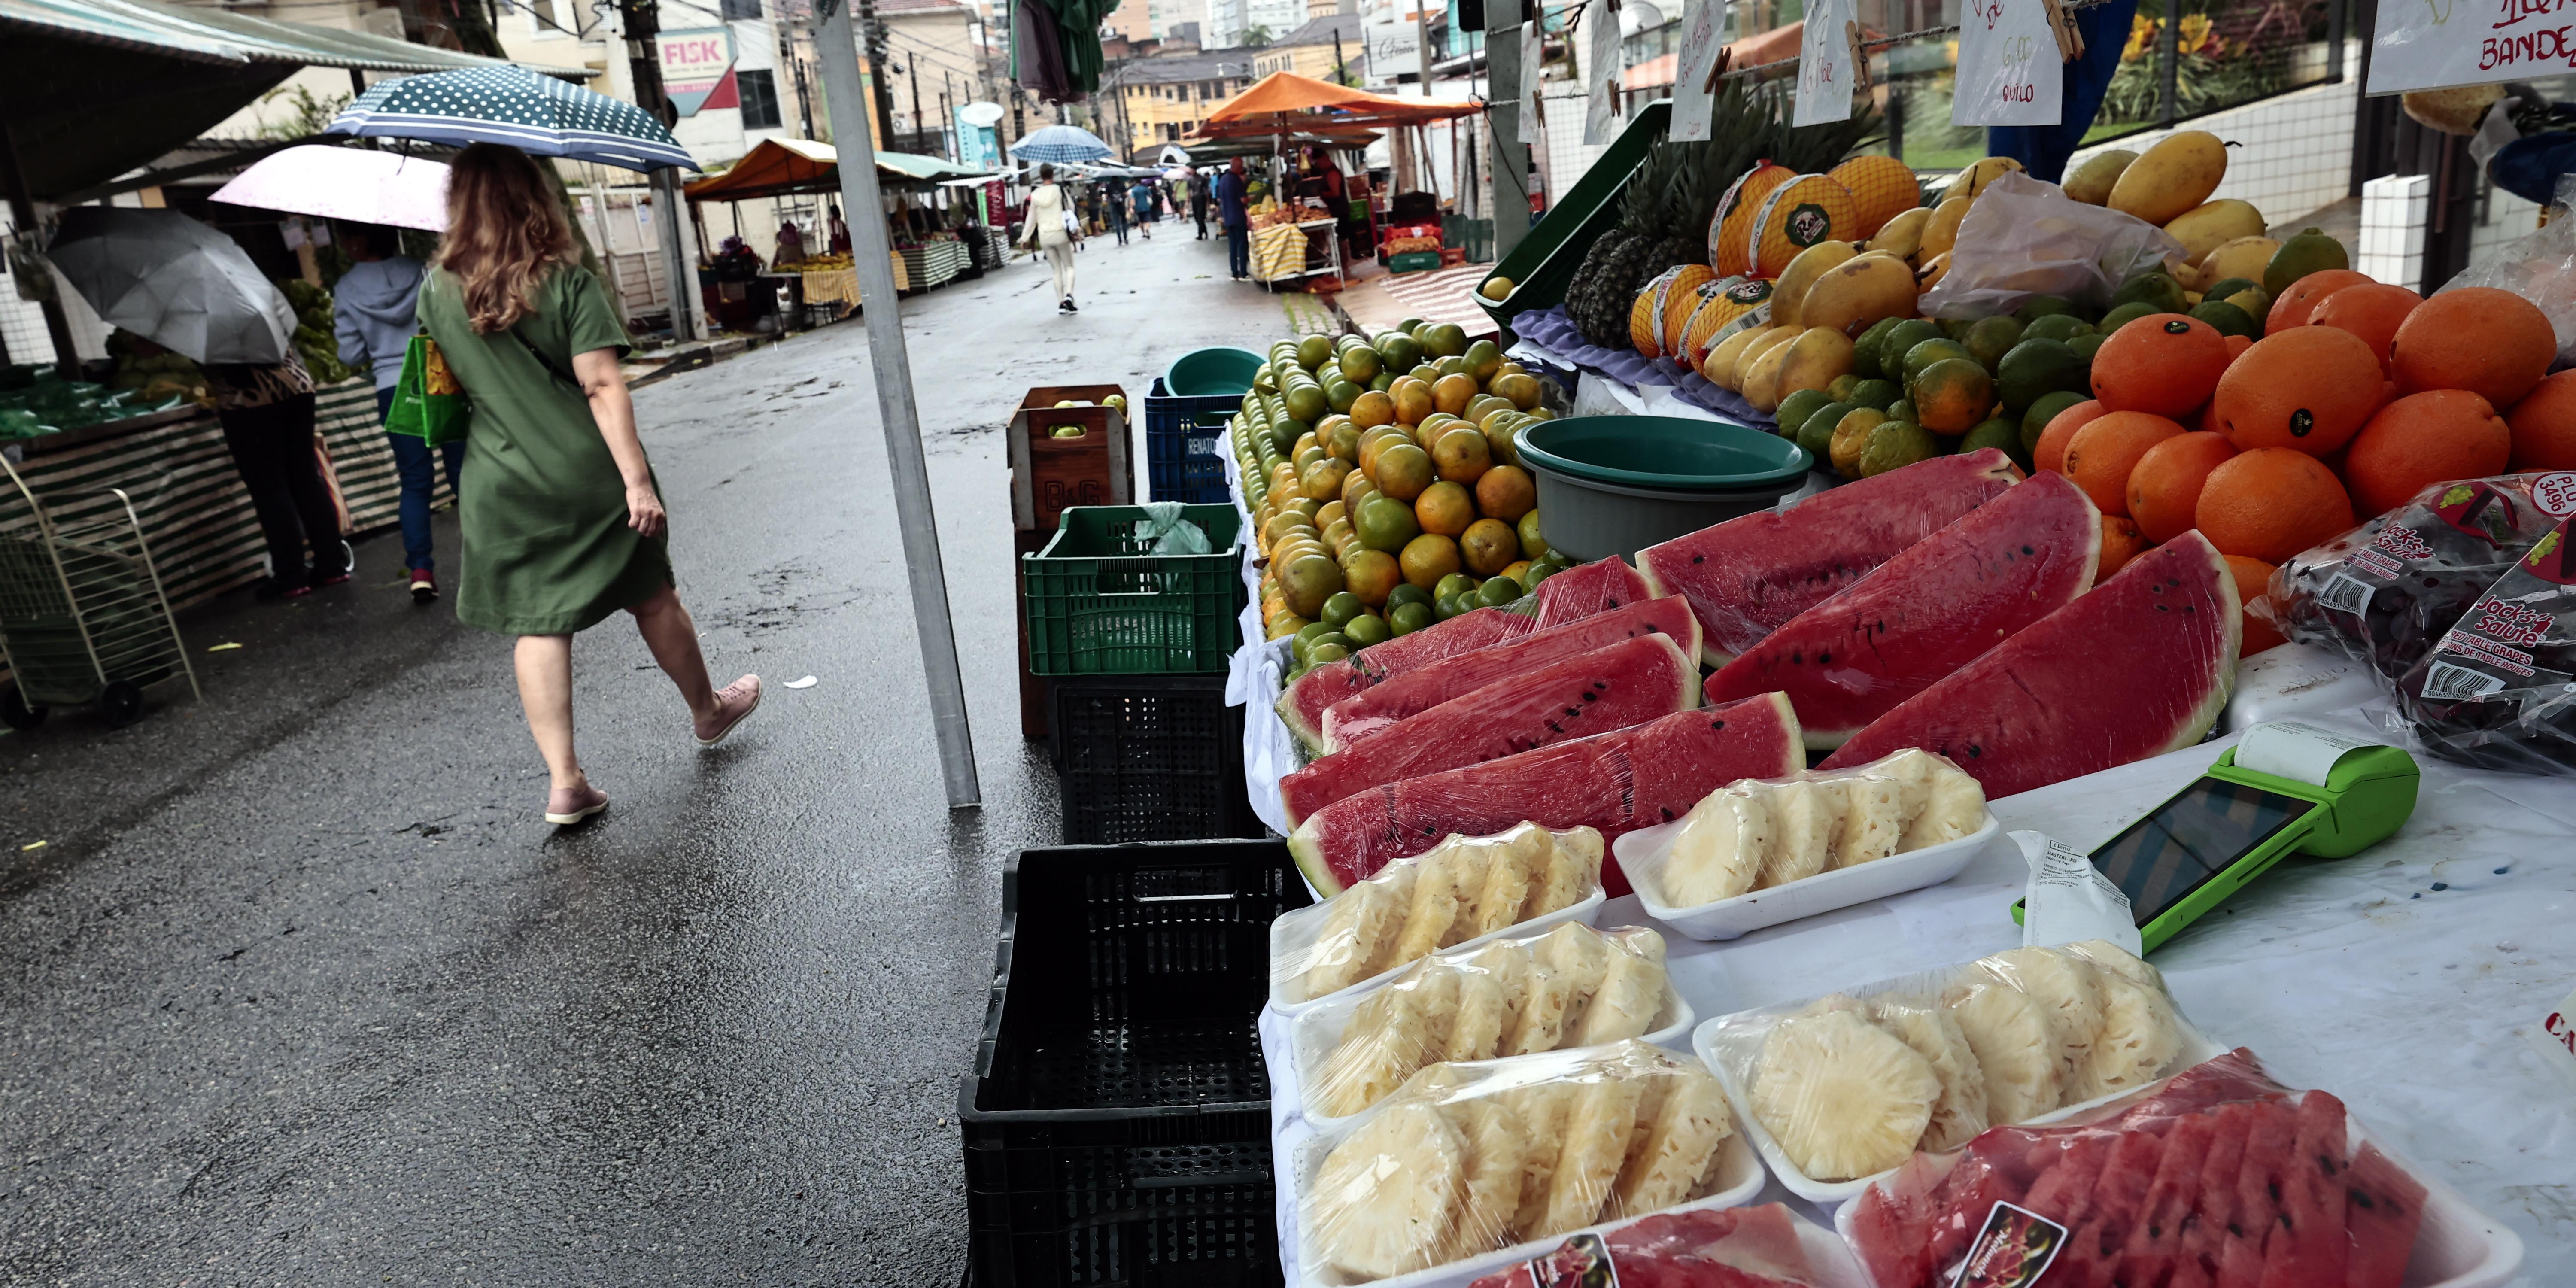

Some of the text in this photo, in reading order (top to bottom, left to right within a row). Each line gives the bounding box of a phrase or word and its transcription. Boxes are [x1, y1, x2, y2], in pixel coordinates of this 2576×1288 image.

[664, 40, 721, 65] FISK
[1188, 438, 1217, 455] RENATO
[1045, 480, 1101, 511] B&G
[2539, 480, 2566, 512] 3496
[2556, 476, 2576, 502] PLU
[2372, 535, 2416, 560] Salute
[2382, 523, 2424, 550] Jack's
[2361, 550, 2379, 562] TABLE
[2376, 555, 2401, 571] GRAPES
[2362, 562, 2379, 574] TABLE
[2377, 568, 2398, 580] ROUGES
[2476, 595, 2536, 623] Jack's
[2474, 616, 2538, 647] Salute
[2464, 647, 2476, 657] DE
[2476, 650, 2502, 666] TABLE
[2501, 661, 2533, 676] ROUGES
[2465, 634, 2491, 651] TABLE
[2492, 644, 2532, 665] GRAPES
[2428, 690, 2450, 698] 804631
[2545, 1012, 2576, 1062] CA
[1973, 1229, 2009, 1279] Melancia
